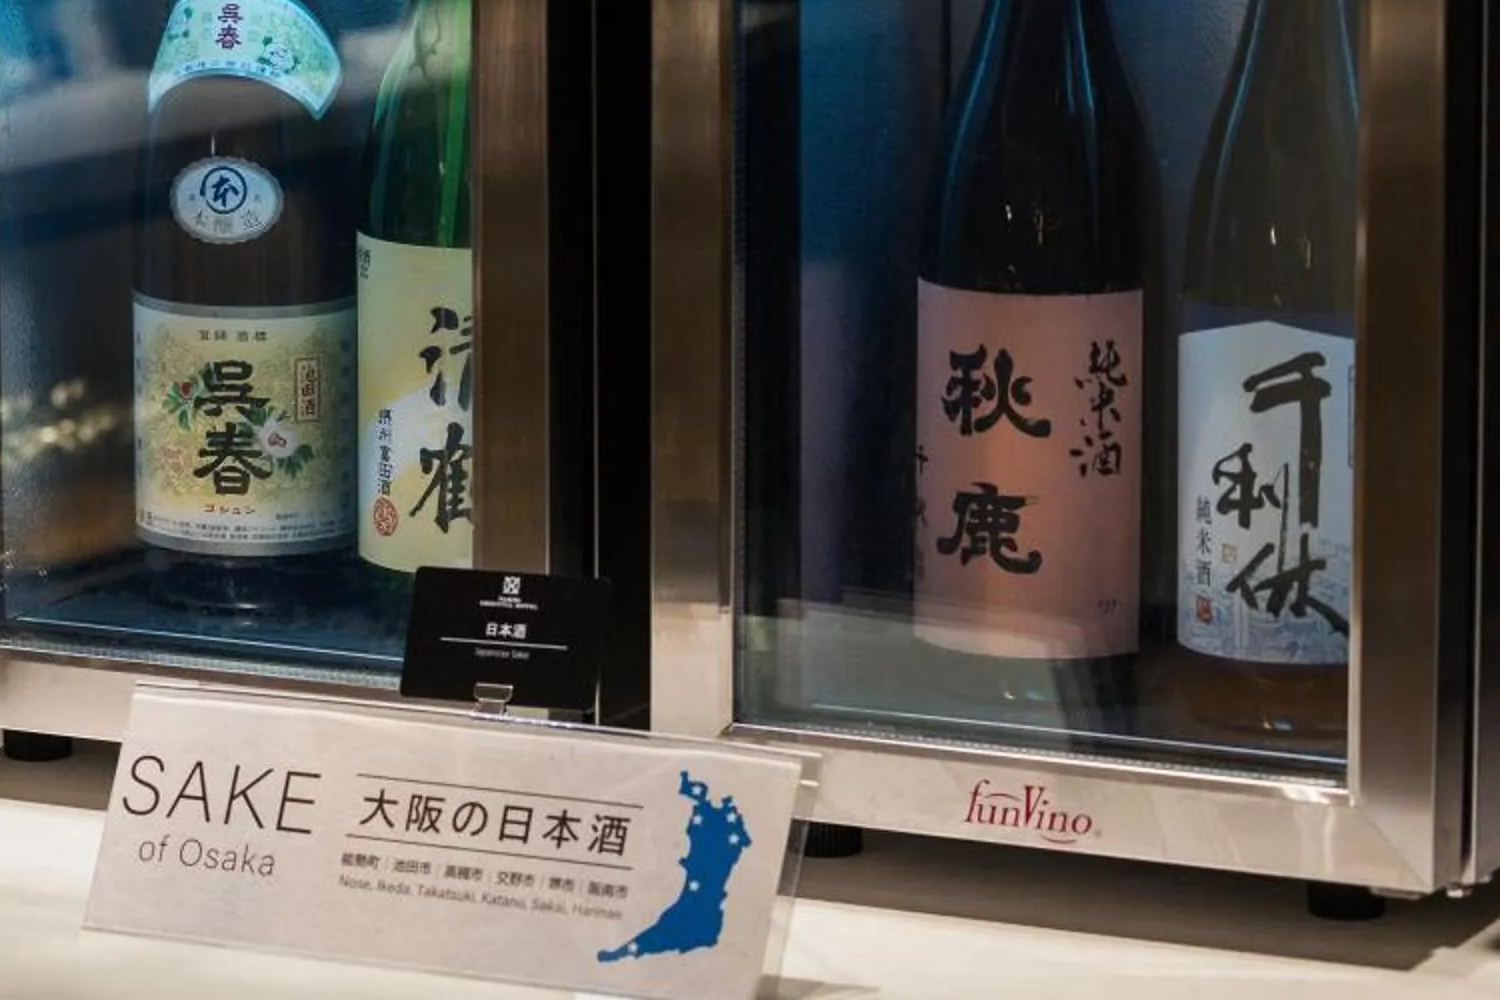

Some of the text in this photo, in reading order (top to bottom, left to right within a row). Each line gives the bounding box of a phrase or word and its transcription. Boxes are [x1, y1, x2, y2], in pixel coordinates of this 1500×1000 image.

[193, 359, 273, 495] 呉春
[1069, 337, 1128, 478] 純米酒
[936, 344, 1052, 574] 秋鹿
[485, 622, 527, 639] 日本酒
[122, 755, 322, 834] SAKE
[358, 788, 632, 857] 大阪の日本酒
[964, 779, 1093, 836] funVino
[138, 834, 276, 876] of Osaka
